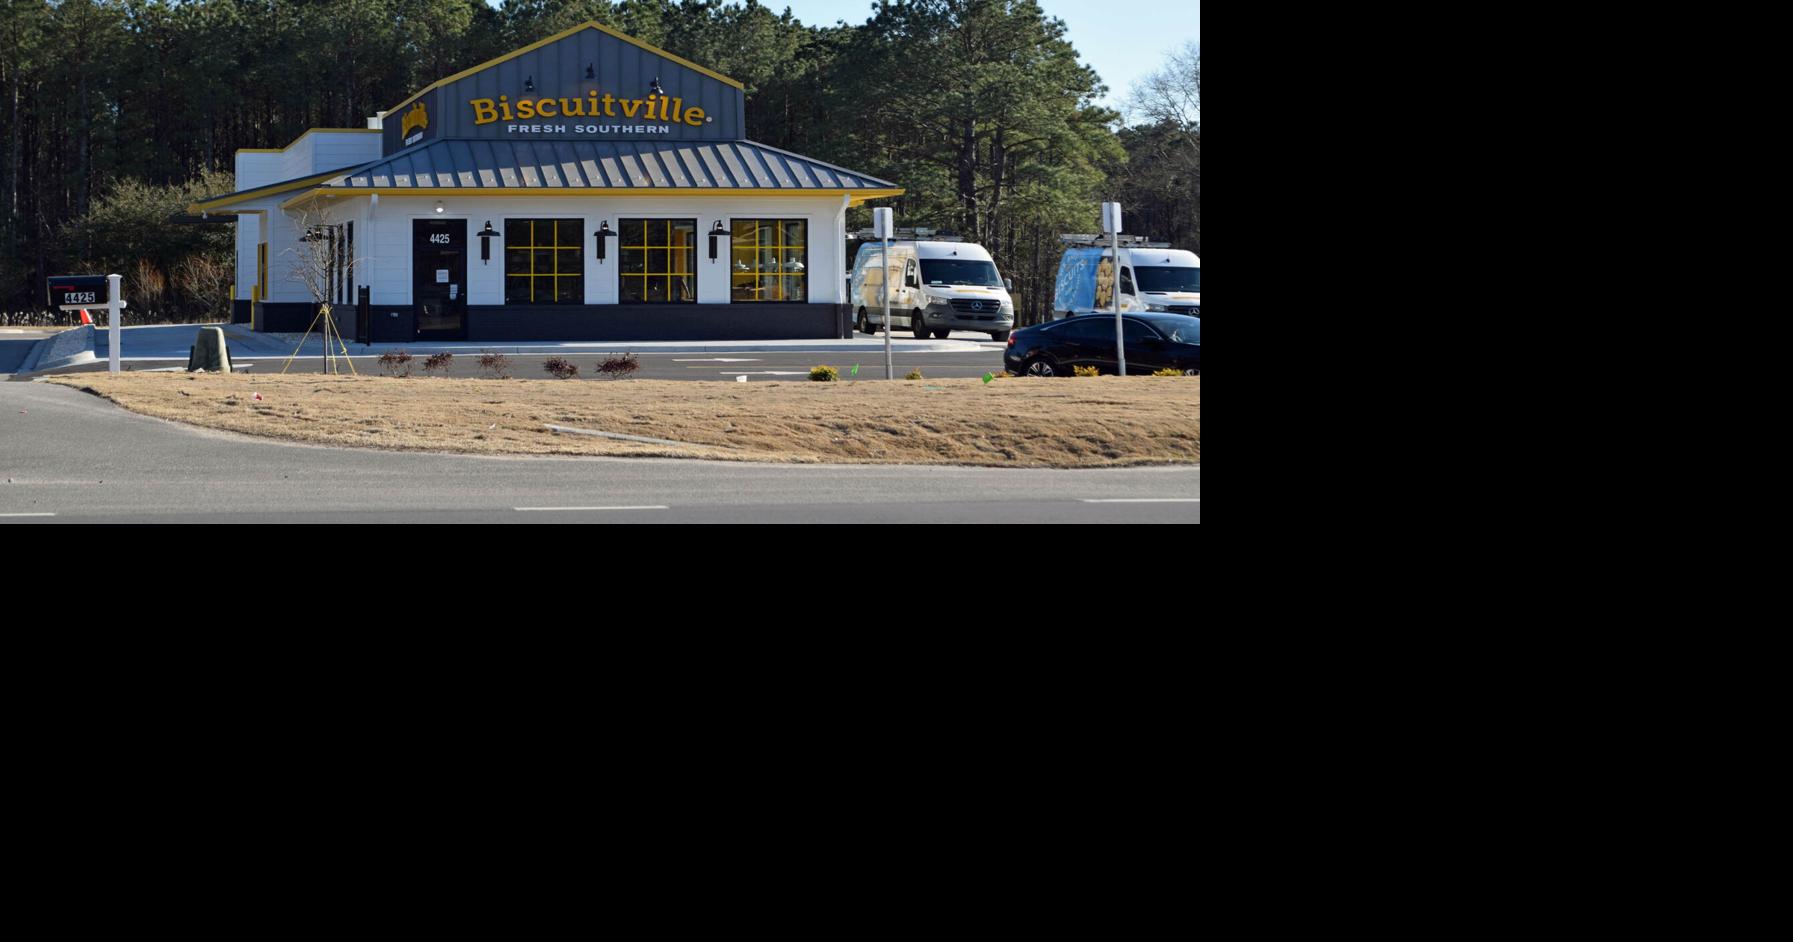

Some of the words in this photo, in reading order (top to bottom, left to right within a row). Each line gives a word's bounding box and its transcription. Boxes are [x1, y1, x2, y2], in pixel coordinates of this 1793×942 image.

[470, 90, 705, 126] Biscuitville
[508, 124, 566, 133] FRESH
[575, 124, 669, 133] SOUTHERN
[430, 233, 450, 244] 4425
[66, 292, 95, 303] 4425
